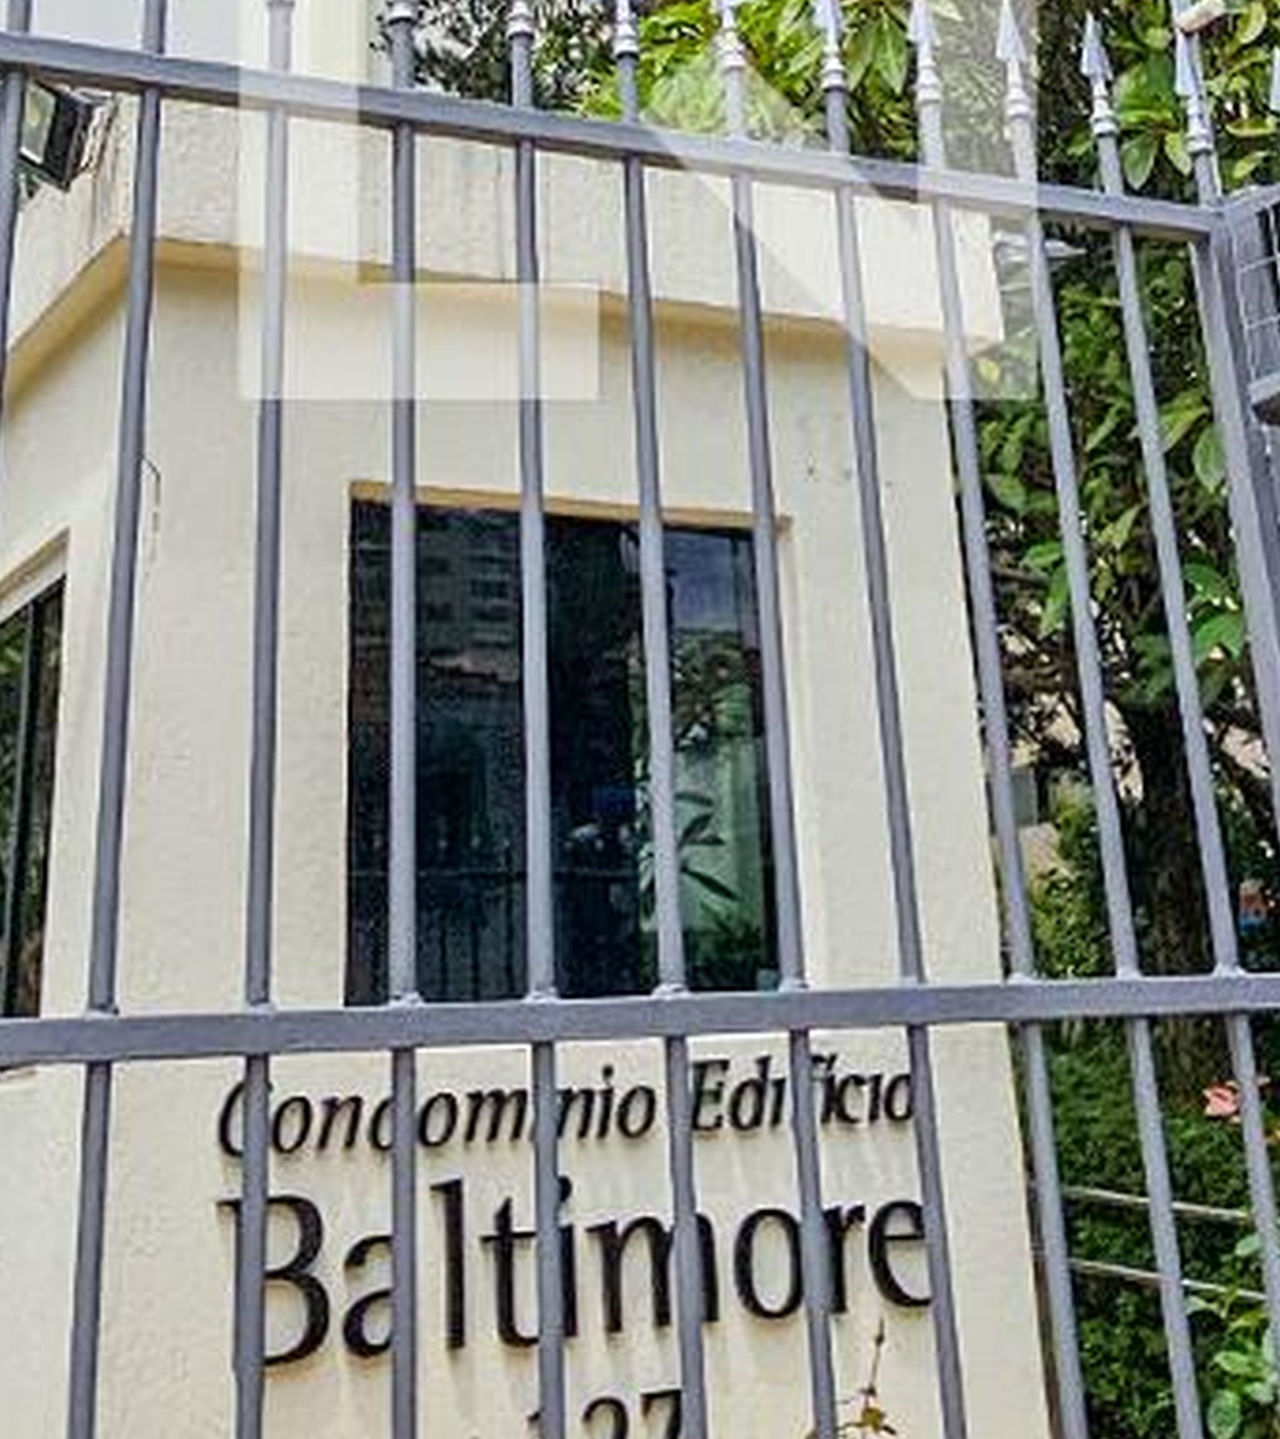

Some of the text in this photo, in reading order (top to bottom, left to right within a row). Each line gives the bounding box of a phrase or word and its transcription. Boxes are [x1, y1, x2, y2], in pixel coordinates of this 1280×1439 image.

[218, 1051, 916, 1157] Conomnio Ediício
[216, 1174, 932, 1366] Baltimore
